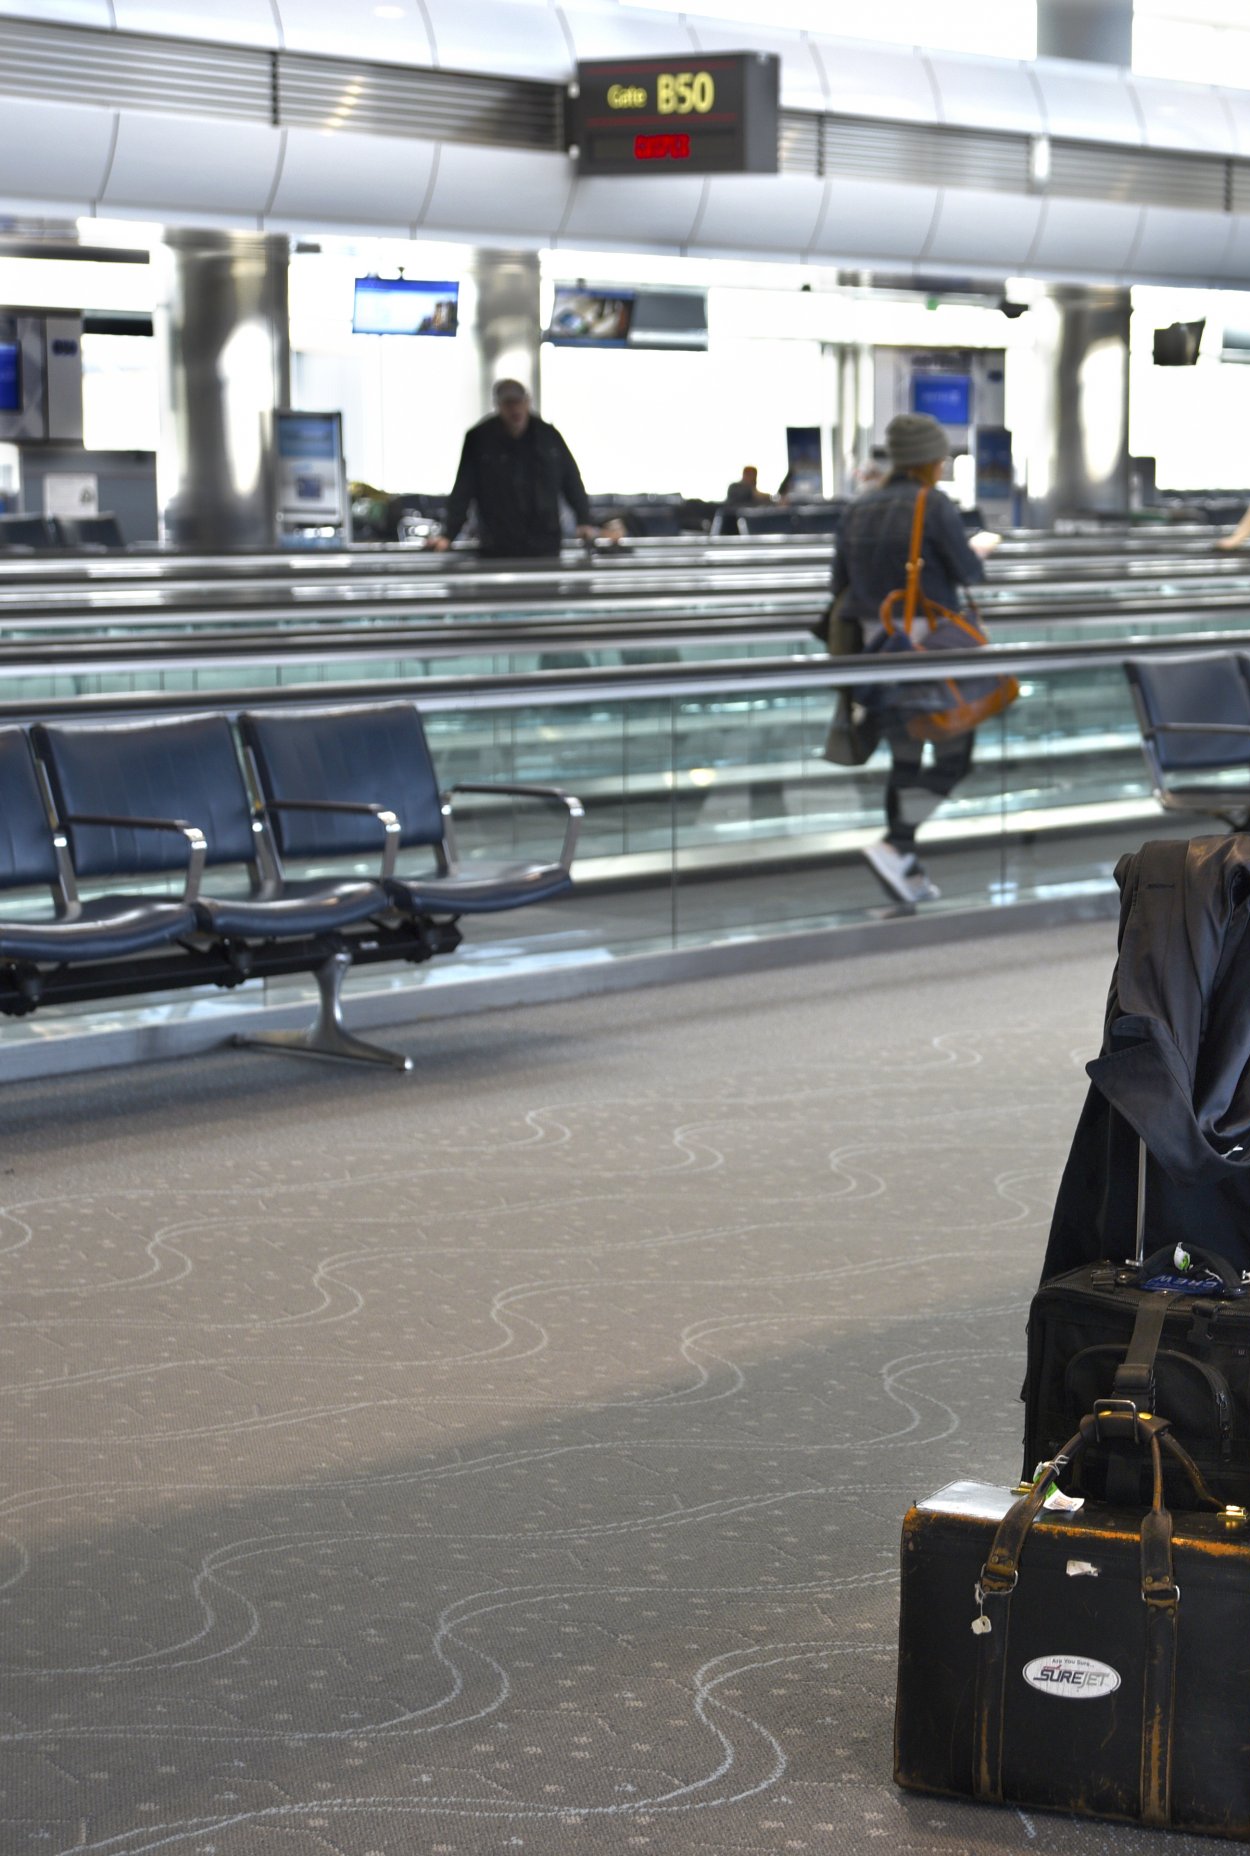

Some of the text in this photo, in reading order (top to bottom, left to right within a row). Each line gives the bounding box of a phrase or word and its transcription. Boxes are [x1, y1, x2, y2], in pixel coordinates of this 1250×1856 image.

[607, 71, 715, 115] Gate B50
[1157, 1275, 1218, 1288] CREW
